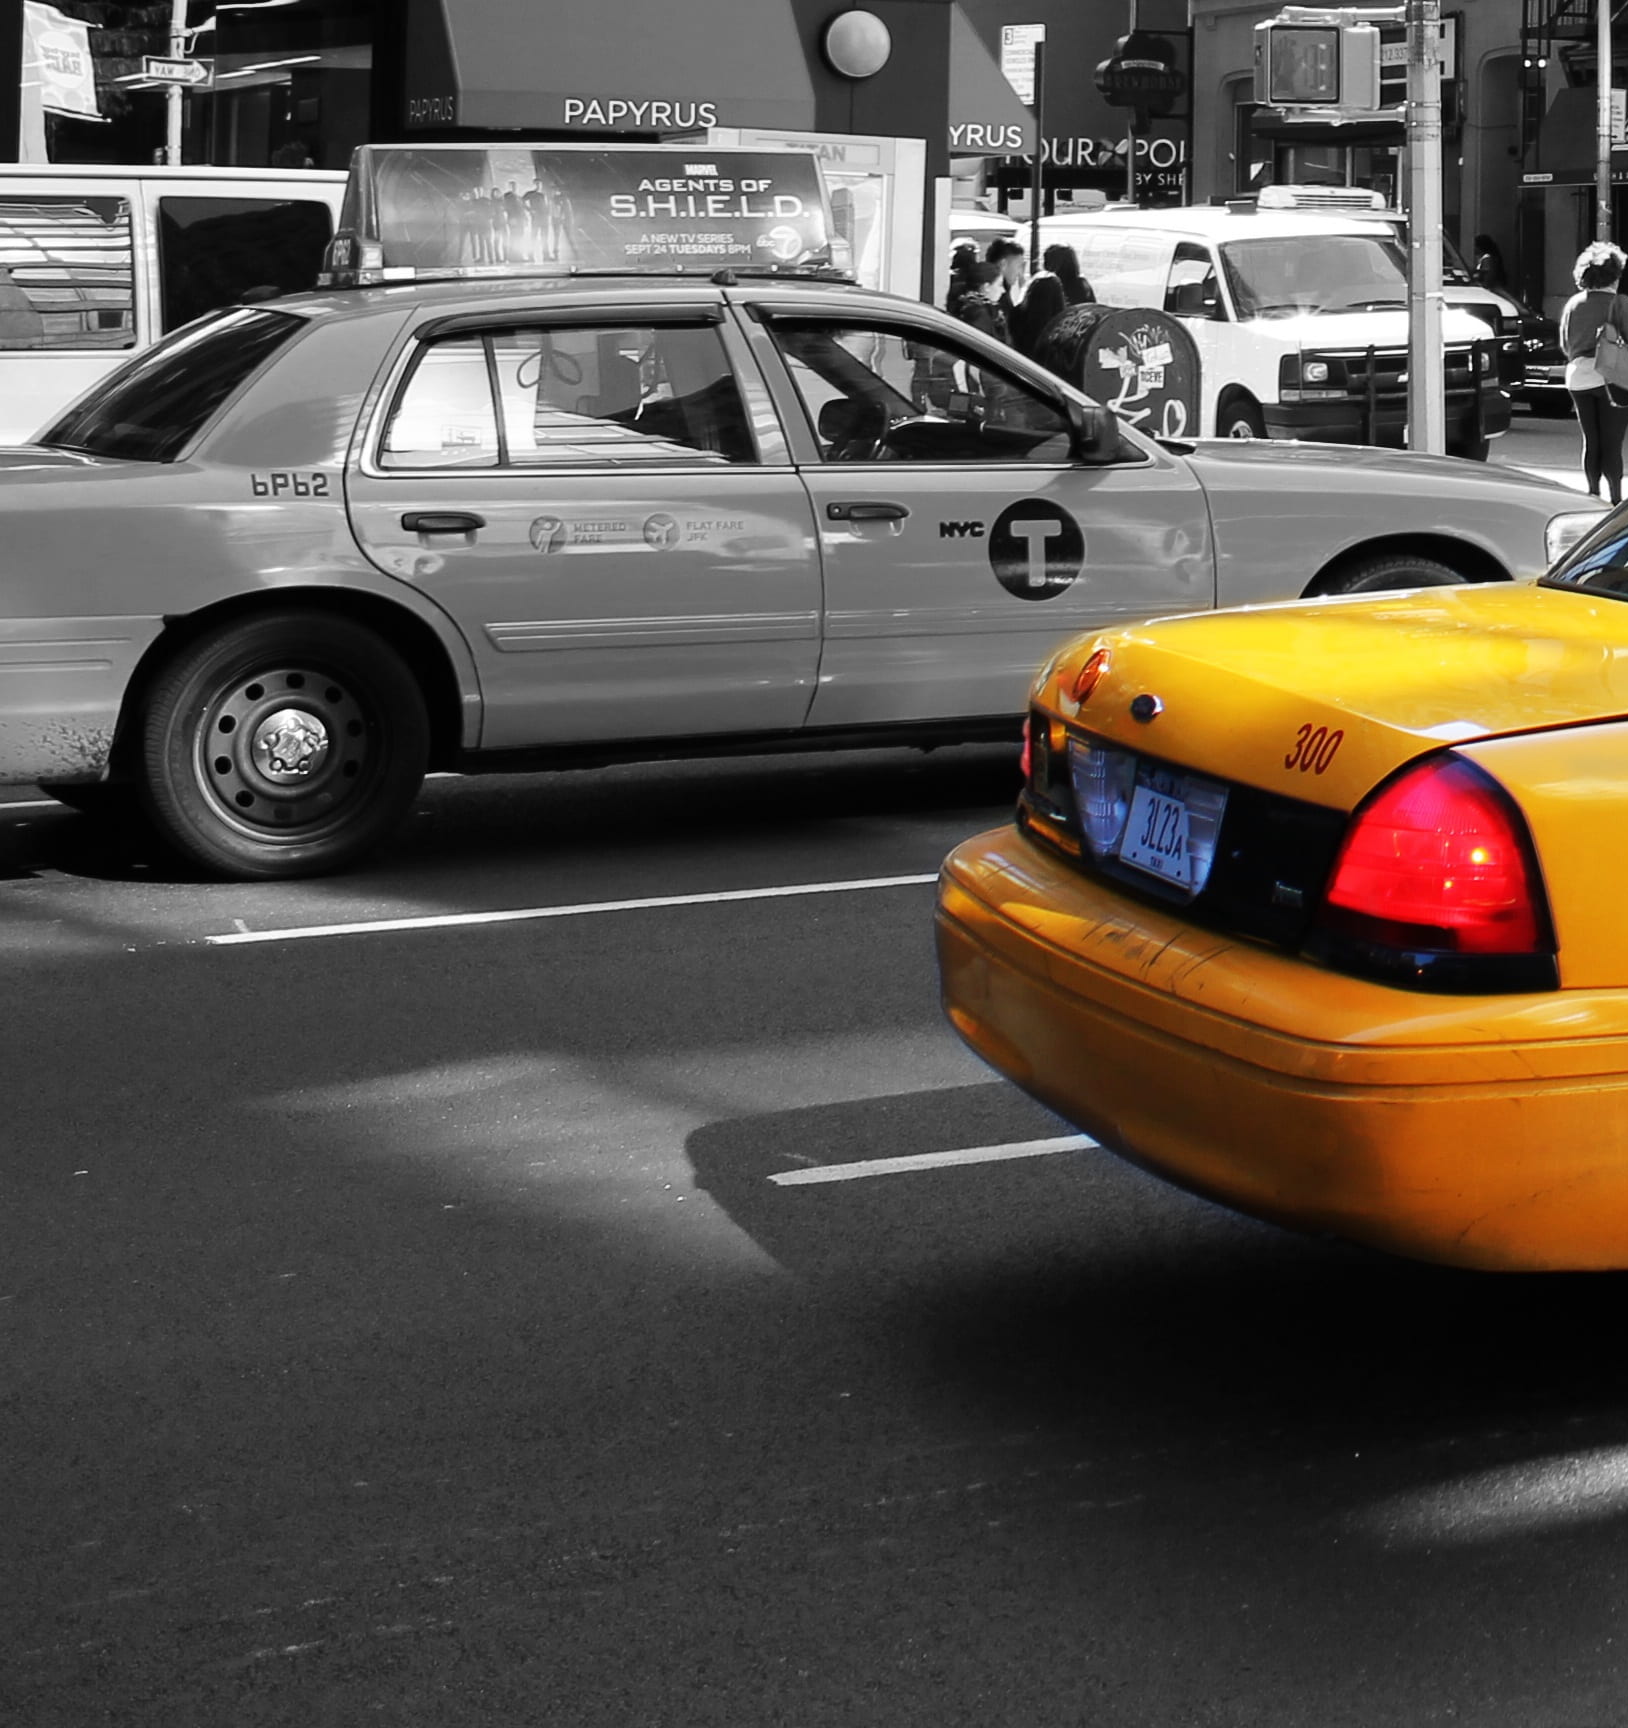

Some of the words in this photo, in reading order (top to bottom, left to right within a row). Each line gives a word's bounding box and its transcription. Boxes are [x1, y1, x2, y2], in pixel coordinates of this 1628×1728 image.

[408, 95, 455, 123] PAPYRUS
[563, 98, 718, 130] PAPYRUS
[949, 123, 1024, 150] YRUS
[1005, 137, 1097, 166] OUR
[637, 178, 735, 193] AGENTS
[740, 178, 773, 193] OF
[609, 193, 811, 219] S.H.I.E.L.D.
[624, 243, 651, 255] SEPT
[653, 243, 668, 255] 24
[669, 243, 727, 255] TUESDAYS
[727, 243, 752, 255] 8PM
[640, 233, 650, 244] A
[650, 233, 681, 244] NEW
[681, 233, 697, 244] TV
[697, 233, 734, 245] SERIES
[573, 522, 627, 534] METERED
[573, 533, 603, 544] FARE
[685, 520, 713, 531] FLAT
[715, 520, 745, 531] FARE
[685, 531, 709, 543] JFK
[938, 521, 986, 538] NYC
[1009, 519, 1063, 589] T
[1284, 722, 1345, 775] 300
[1140, 797, 1184, 861] 3L23A
